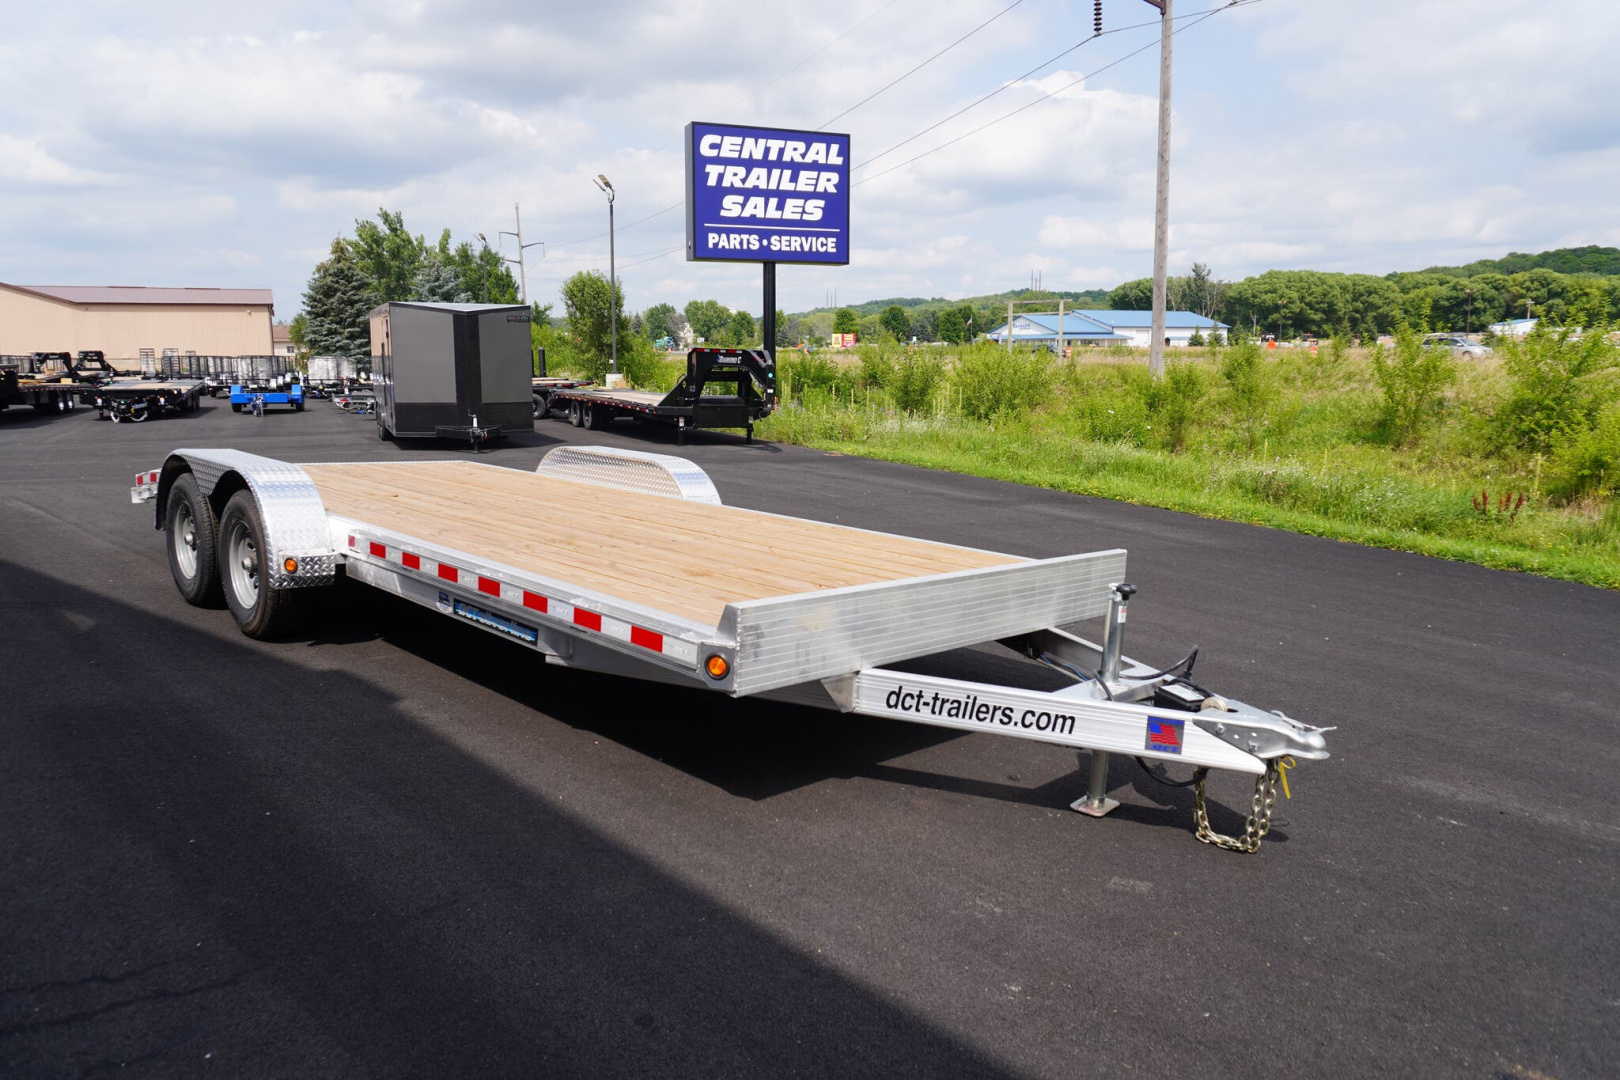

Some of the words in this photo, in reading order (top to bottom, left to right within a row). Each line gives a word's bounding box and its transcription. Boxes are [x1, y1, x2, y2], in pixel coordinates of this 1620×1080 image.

[699, 134, 844, 165] CENTRAL
[704, 164, 840, 193] TRAILER
[719, 194, 826, 221] SALES
[707, 232, 760, 250] PARTS
[769, 235, 837, 253] SERVICE
[885, 685, 1076, 734] dct-trailers.com
